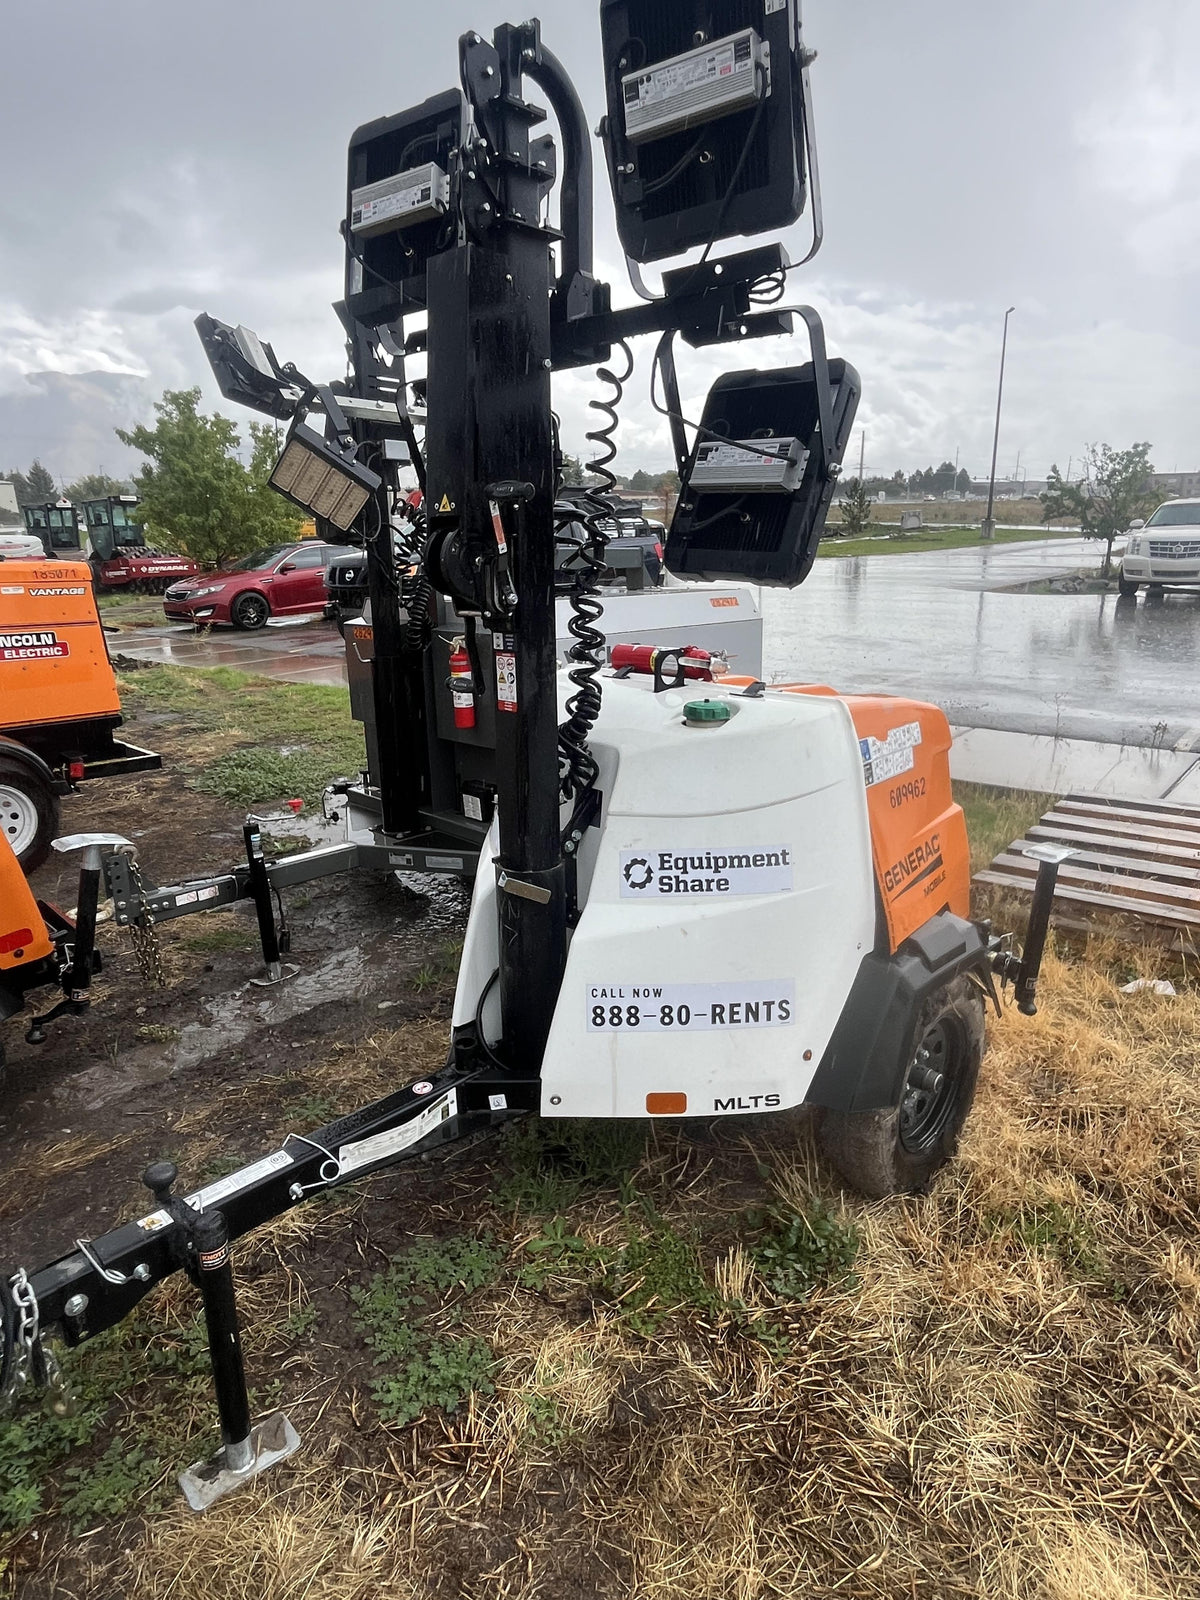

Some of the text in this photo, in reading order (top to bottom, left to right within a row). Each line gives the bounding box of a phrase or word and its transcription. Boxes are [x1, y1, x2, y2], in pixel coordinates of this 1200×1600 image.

[32, 569, 77, 580] 185071
[29, 587, 86, 596] VANTAGE
[4, 647, 63, 659] ELECTRIC
[890, 777, 926, 808] 609962
[658, 849, 790, 874] Equipment
[884, 834, 940, 892] GENERAC
[658, 875, 730, 893] Share
[923, 870, 946, 897] MOBILE
[591, 988, 663, 998] CALL NOW
[591, 999, 791, 1026] 888-80-RENTS
[714, 1093, 781, 1111] MLTS
[202, 1248, 225, 1260] KNOTT
